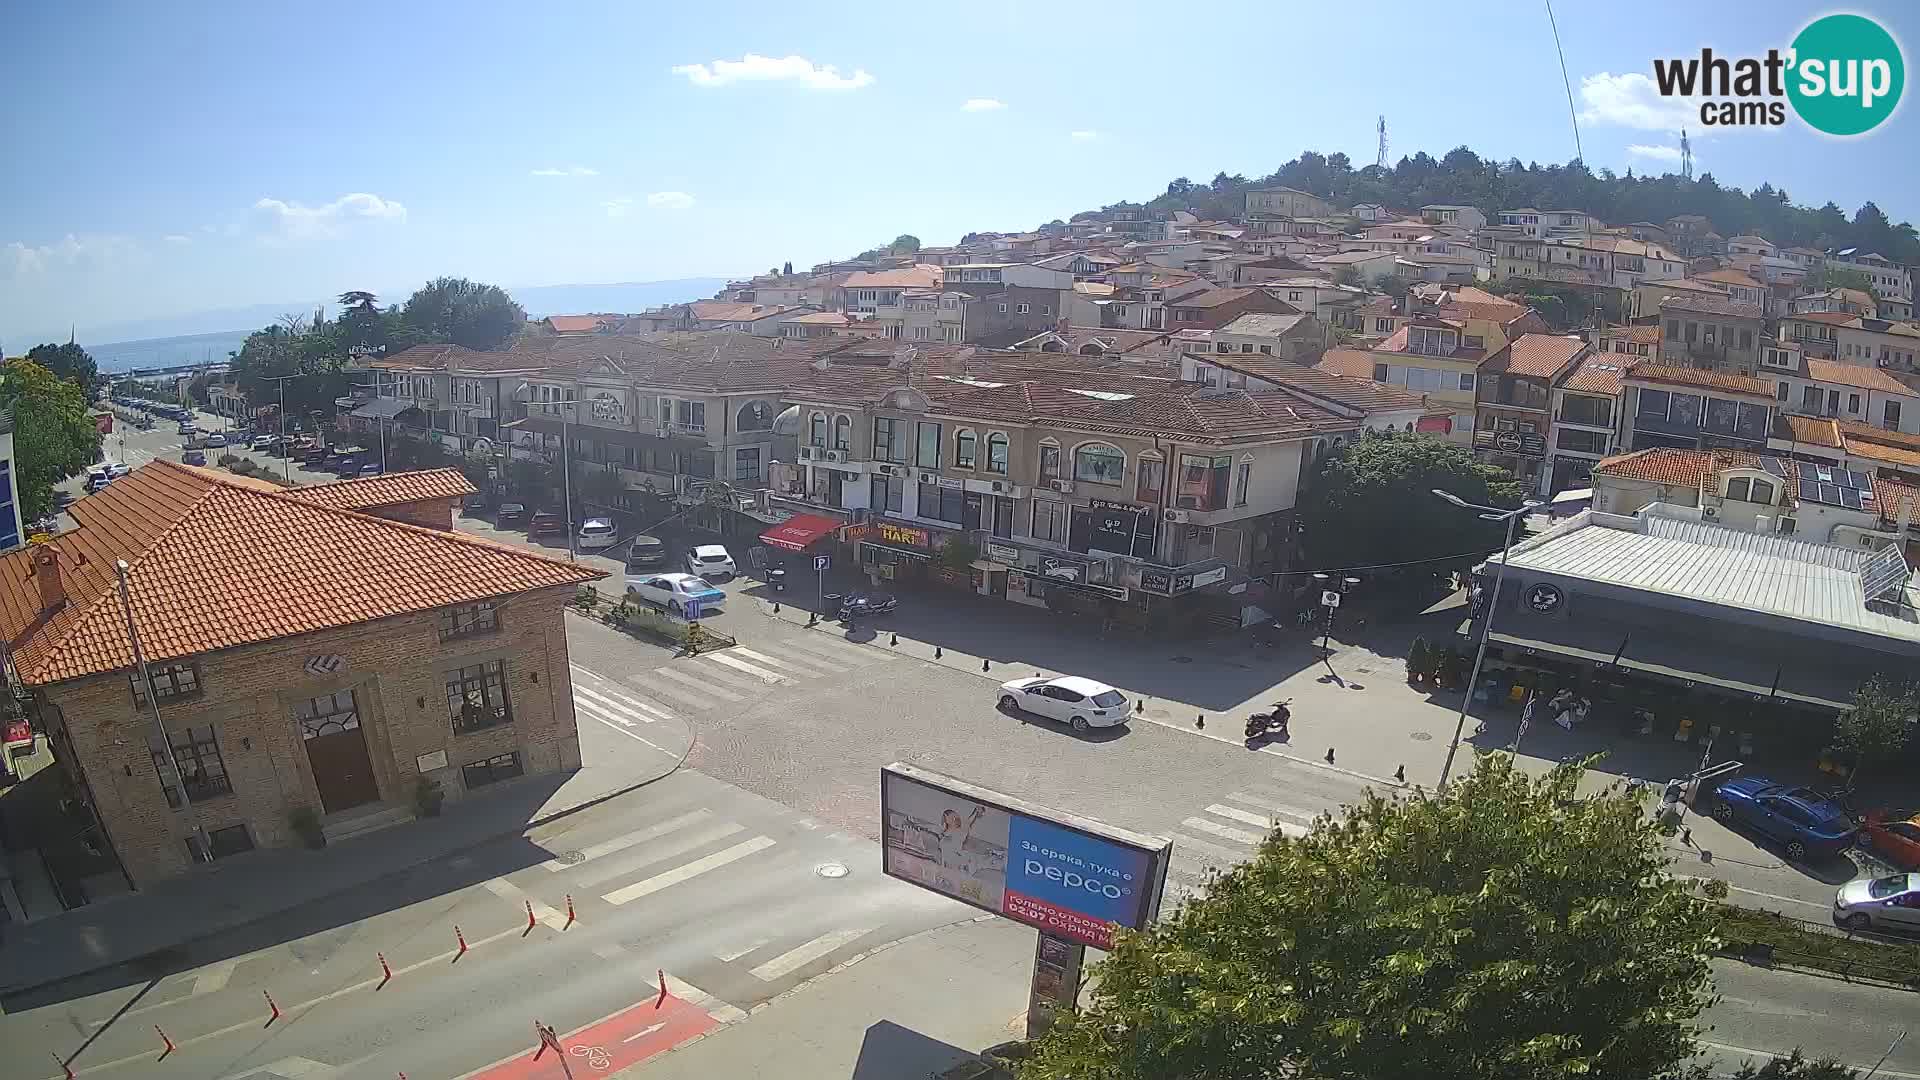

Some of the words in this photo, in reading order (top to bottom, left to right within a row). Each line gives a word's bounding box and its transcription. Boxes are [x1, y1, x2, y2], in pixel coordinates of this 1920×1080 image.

[883, 529, 915, 545] HARI
[818, 558, 826, 569] P
[1021, 840, 1038, 852] За
[1089, 861, 1120, 877] тука
[1123, 873, 1133, 881] е
[1024, 858, 1121, 899] pepco
[1009, 895, 1056, 915] ГОЛЕМО
[1009, 903, 1046, 921] 02.07
[1048, 917, 1095, 940] Охрид
